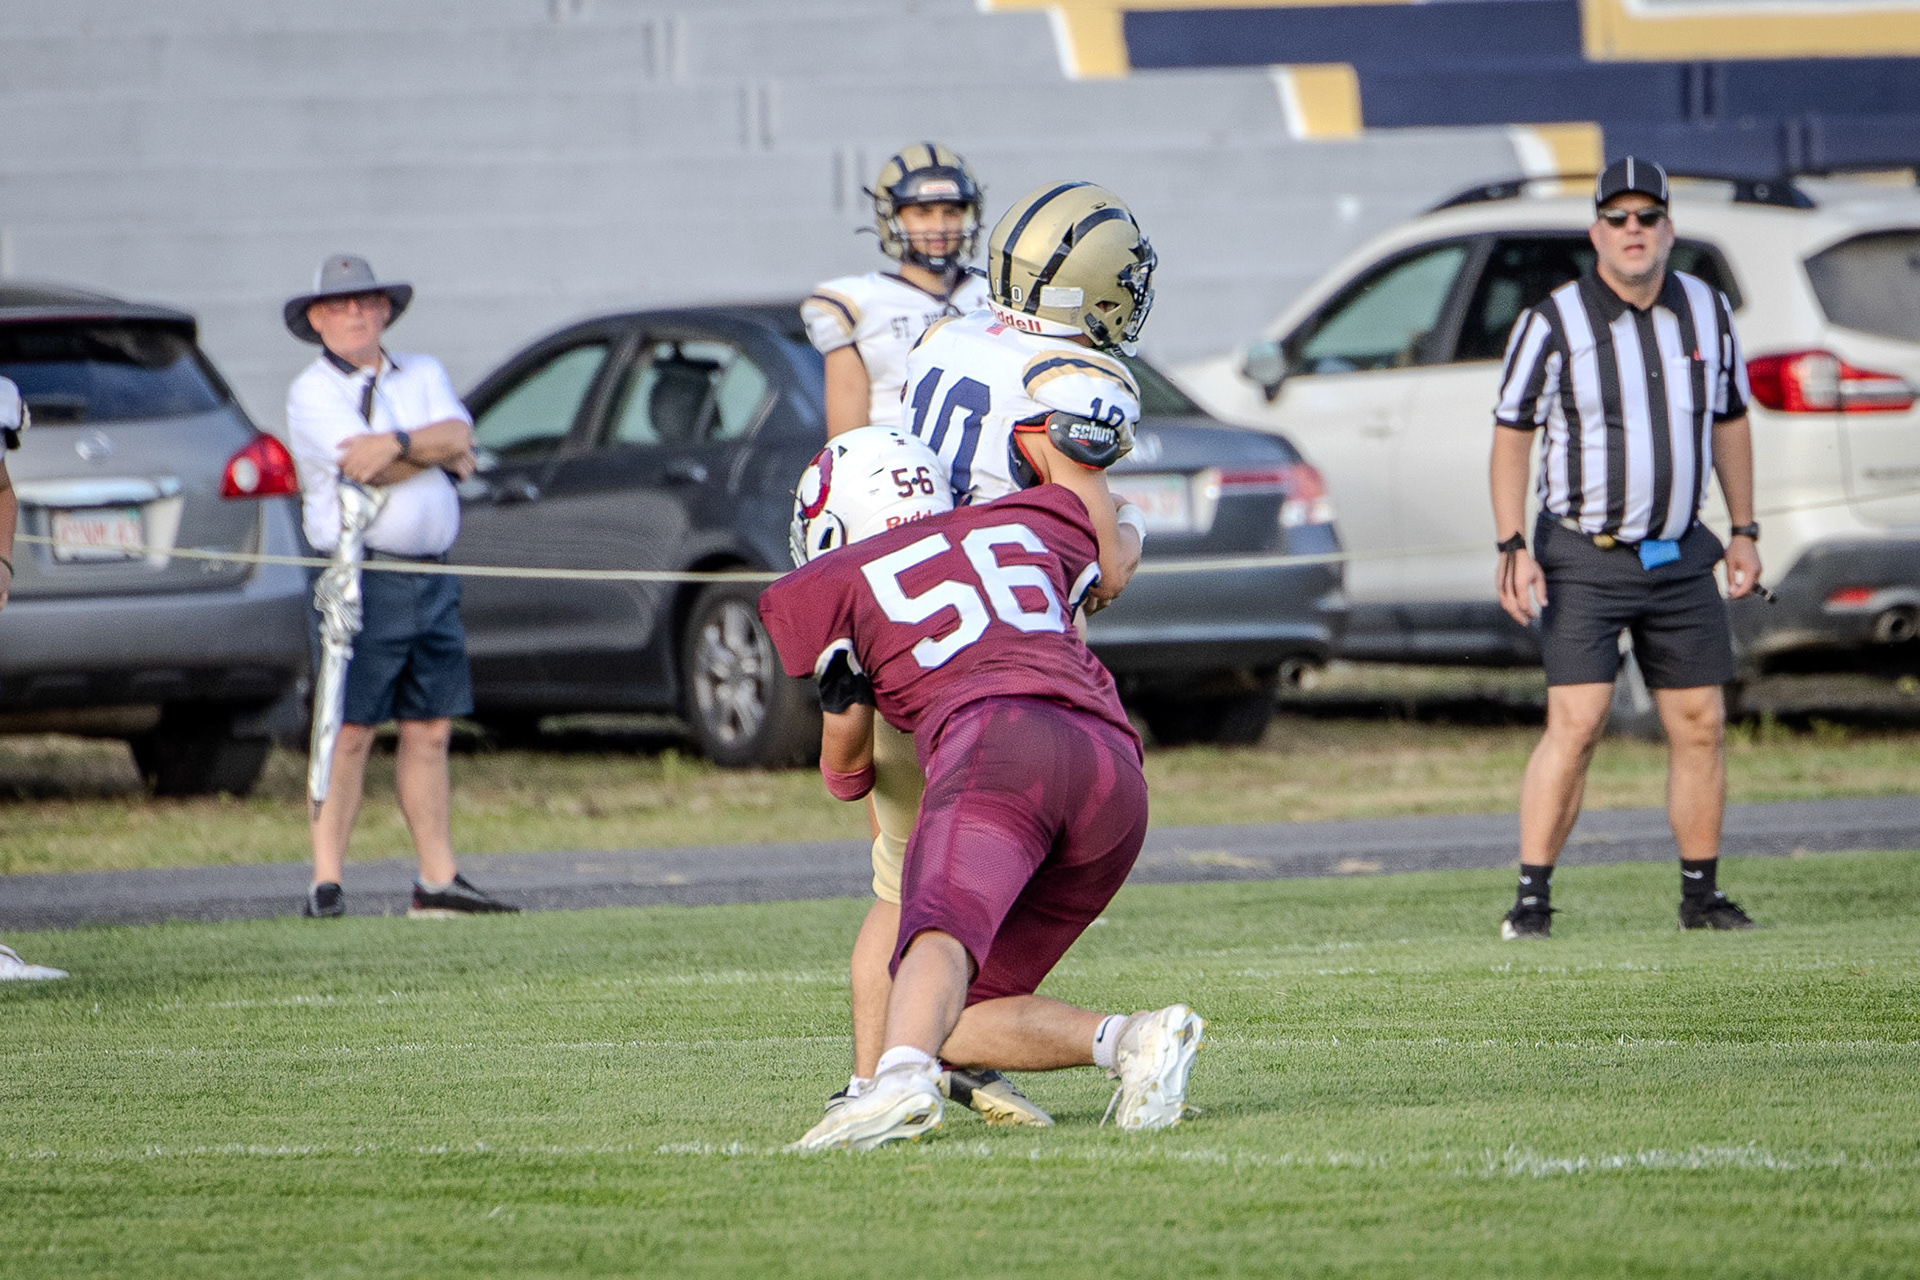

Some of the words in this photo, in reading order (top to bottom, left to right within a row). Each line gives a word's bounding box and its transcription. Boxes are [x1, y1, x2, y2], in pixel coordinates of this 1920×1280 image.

[994, 278, 1023, 302] 10
[1090, 396, 1125, 429] 10
[911, 366, 991, 494] 10
[890, 465, 935, 499] 56
[860, 522, 1066, 669] 56
